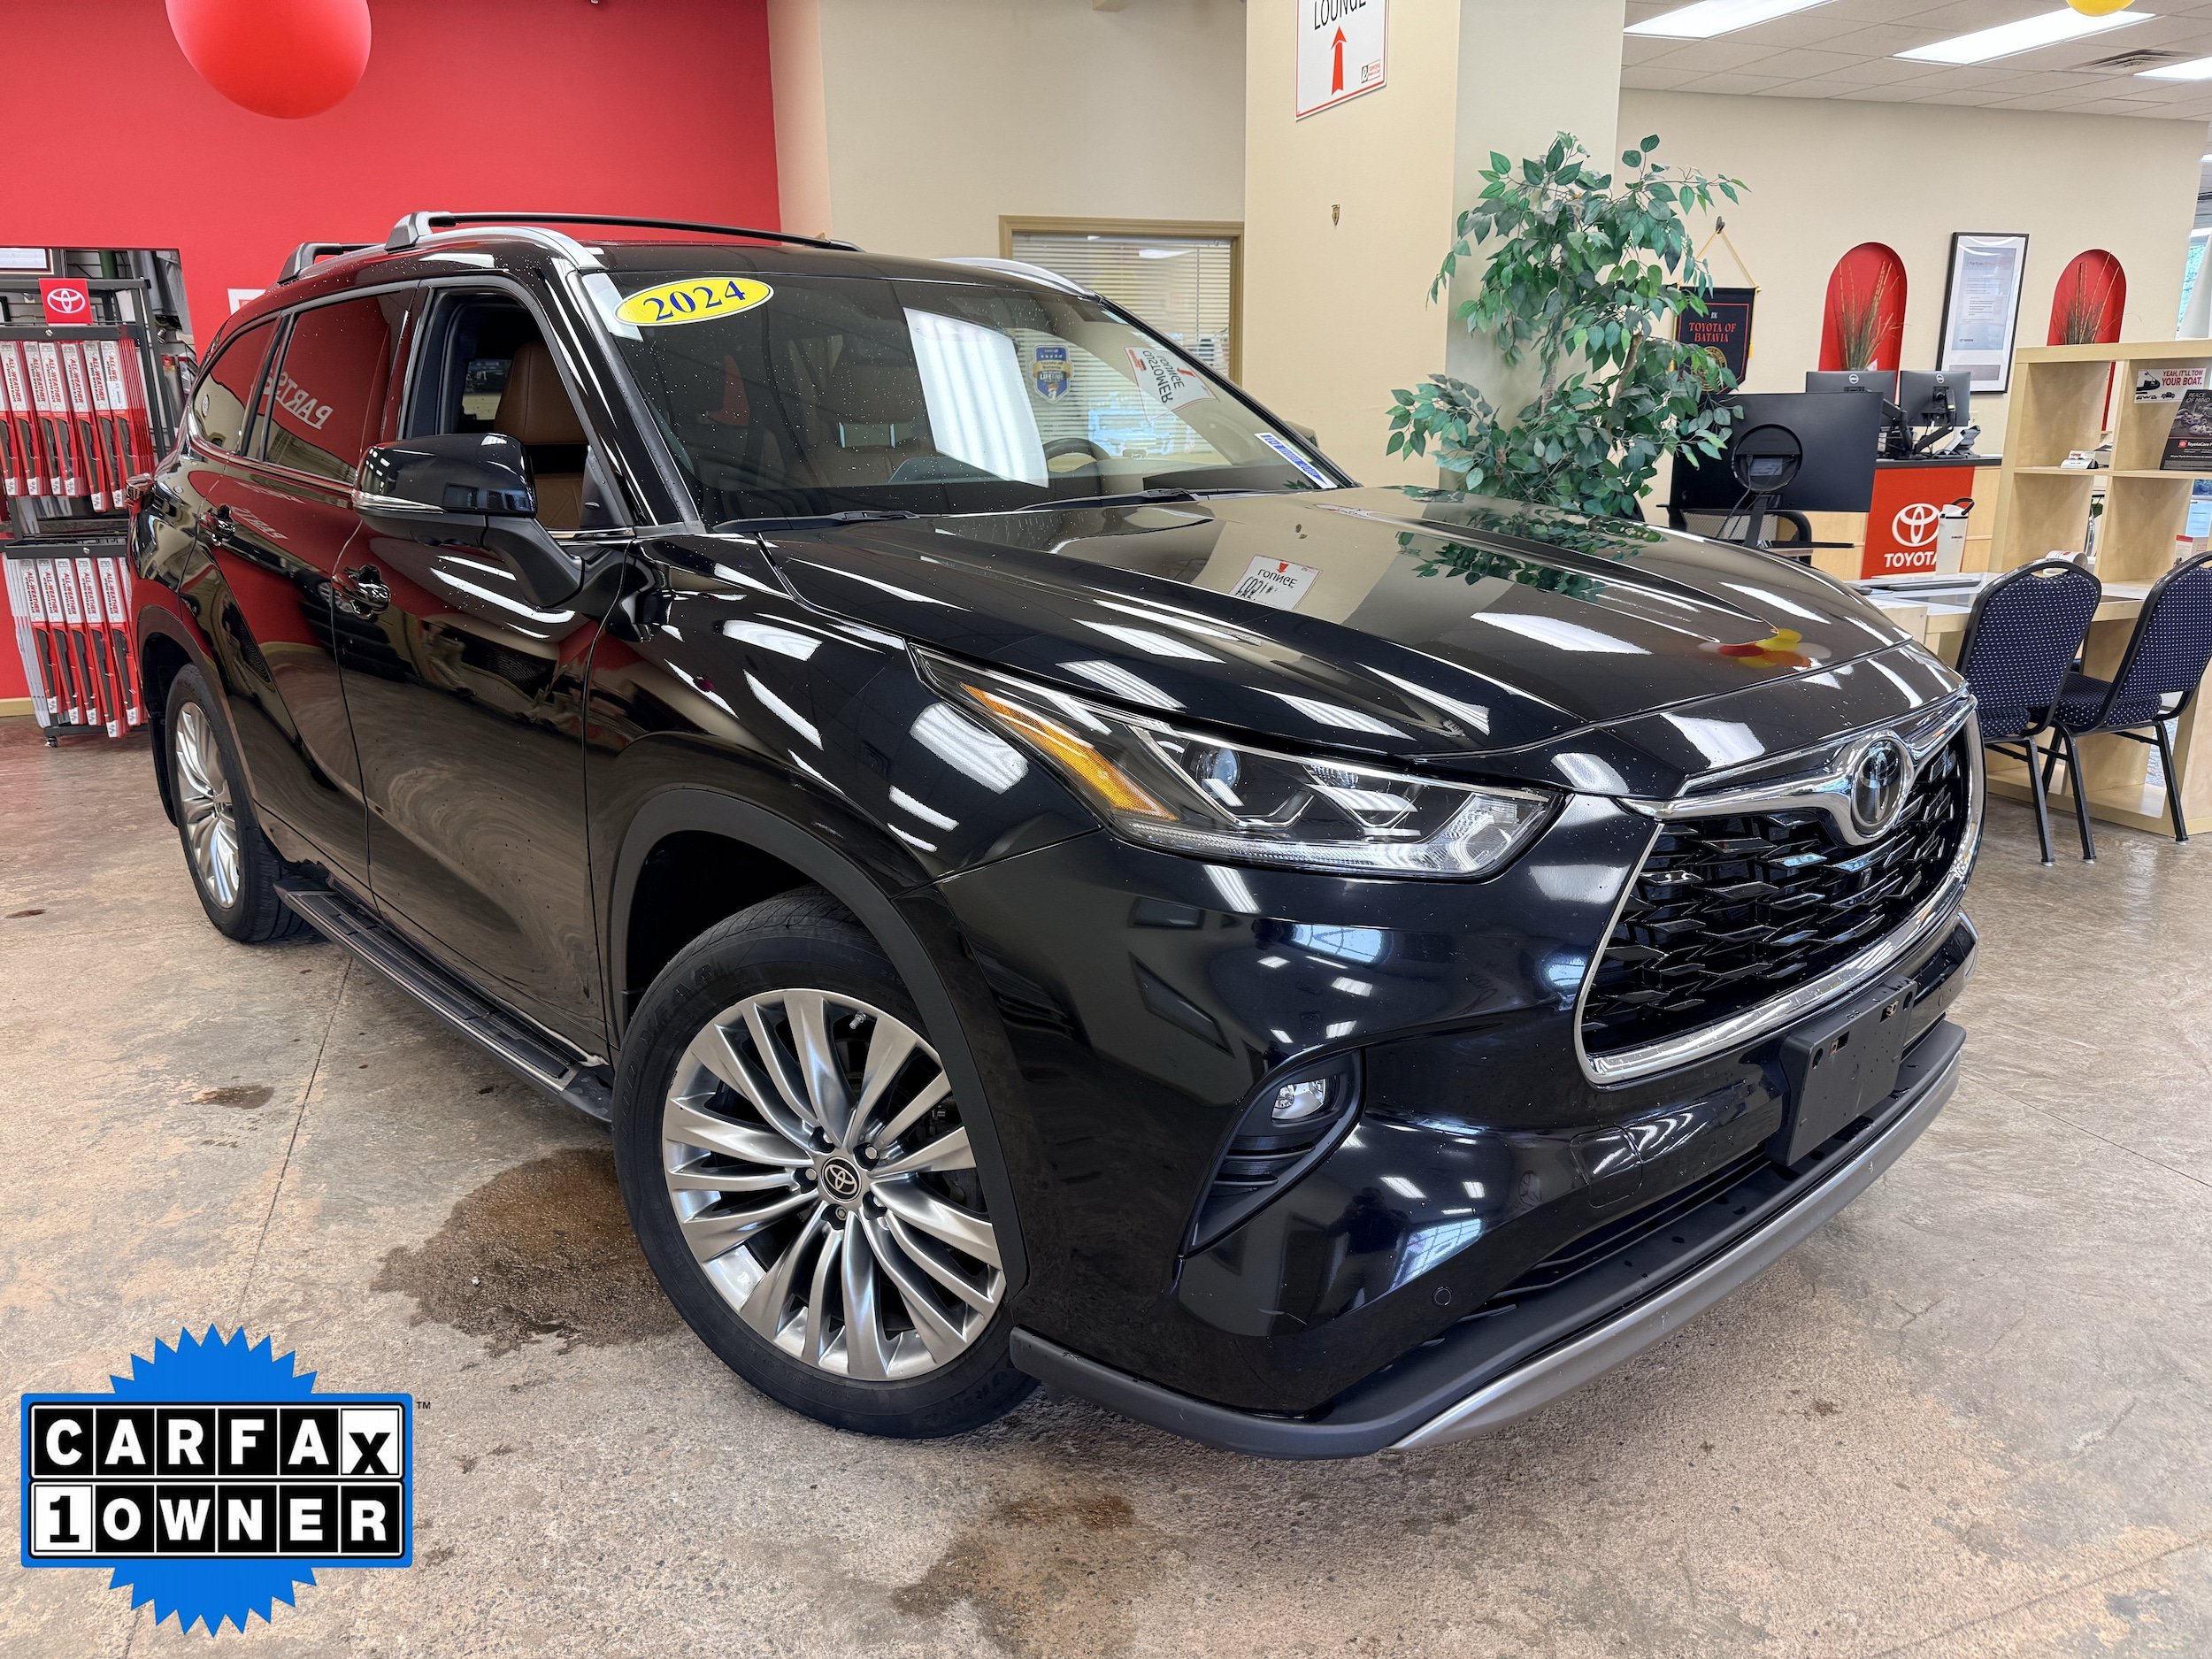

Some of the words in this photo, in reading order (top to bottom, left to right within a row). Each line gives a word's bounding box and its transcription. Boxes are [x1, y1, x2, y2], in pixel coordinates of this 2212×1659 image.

[1314, 0, 1366, 30] LOUN
[642, 280, 746, 321] 2024
[1689, 322, 1722, 333] TOYOTA
[1724, 323, 1737, 333] OF
[1694, 333, 1729, 342] BATAVIA
[8, 357, 21, 402] ALL-WEATHER
[33, 357, 45, 402] ALL-WEATHER
[48, 358, 61, 403] ALL-WEATHER
[71, 359, 83, 403] ALL-WEATHER
[92, 357, 104, 401] ALL-WEATHER
[109, 356, 118, 381] ALL-WE
[2162, 378, 2181, 387] YOUR
[2182, 377, 2202, 386] BOAT.
[27, 572, 40, 612] ALL-WEATHER
[45, 572, 58, 613] ALL-WEATHER
[64, 573, 76, 614] ALL-WEATHER
[84, 572, 96, 613] ALL-WEATHER
[106, 572, 118, 613] ALL-WEATHER
